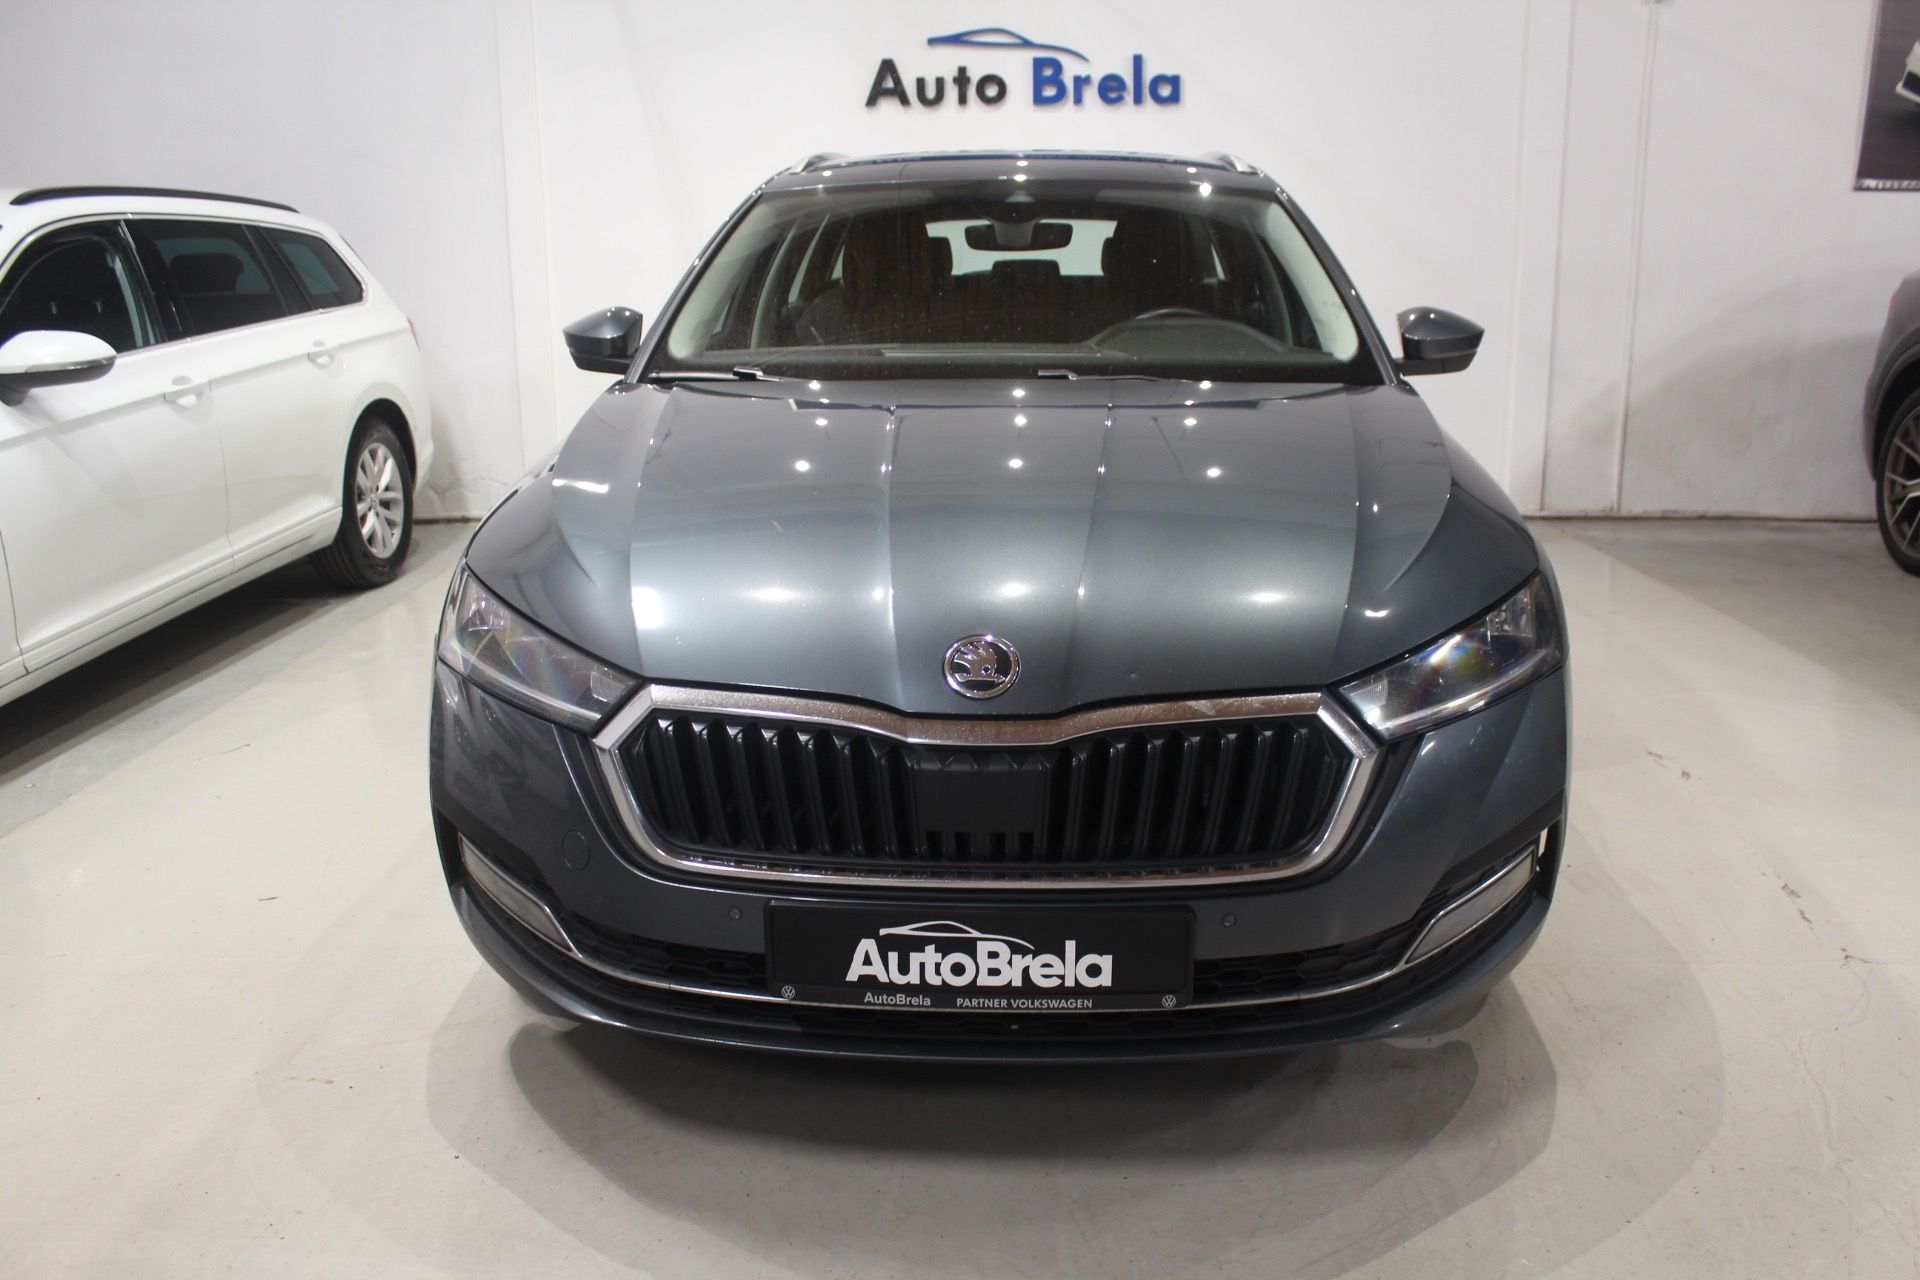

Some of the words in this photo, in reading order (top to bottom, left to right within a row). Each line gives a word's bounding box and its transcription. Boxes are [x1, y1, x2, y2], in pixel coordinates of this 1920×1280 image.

[865, 58, 1007, 107] Auto
[1032, 54, 1181, 106] Brela
[845, 938, 1113, 988] AutoBrela
[864, 992, 931, 1006] AutoBrela
[956, 998, 1008, 1008] PARTNER
[1011, 999, 1093, 1009] VOLKSWAGEN
